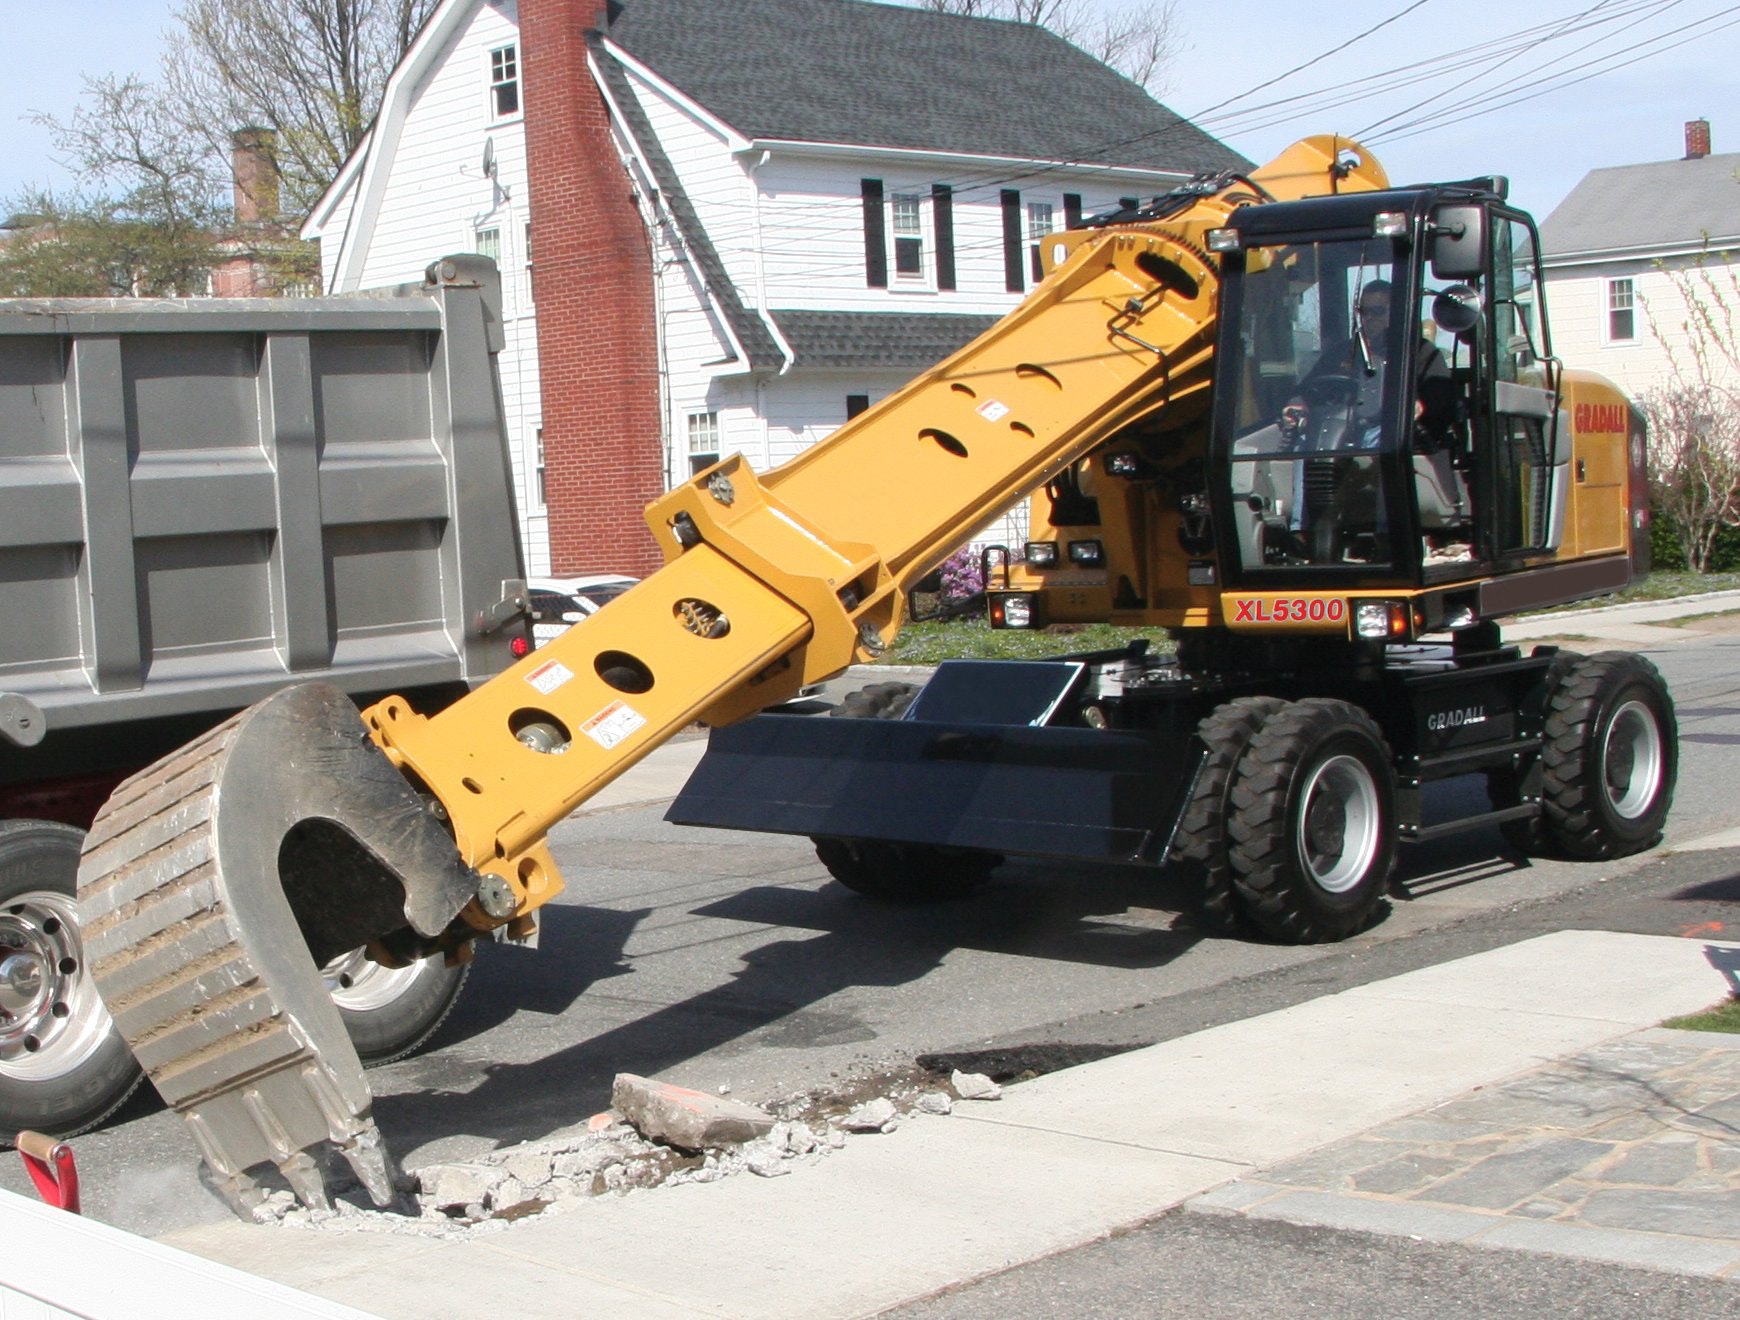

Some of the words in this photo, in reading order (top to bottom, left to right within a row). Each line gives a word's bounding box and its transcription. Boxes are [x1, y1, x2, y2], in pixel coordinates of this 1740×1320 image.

[1575, 403, 1625, 433] GRADALL
[1234, 598, 1345, 622] XL5300
[1427, 705, 1486, 730] GRADALL
